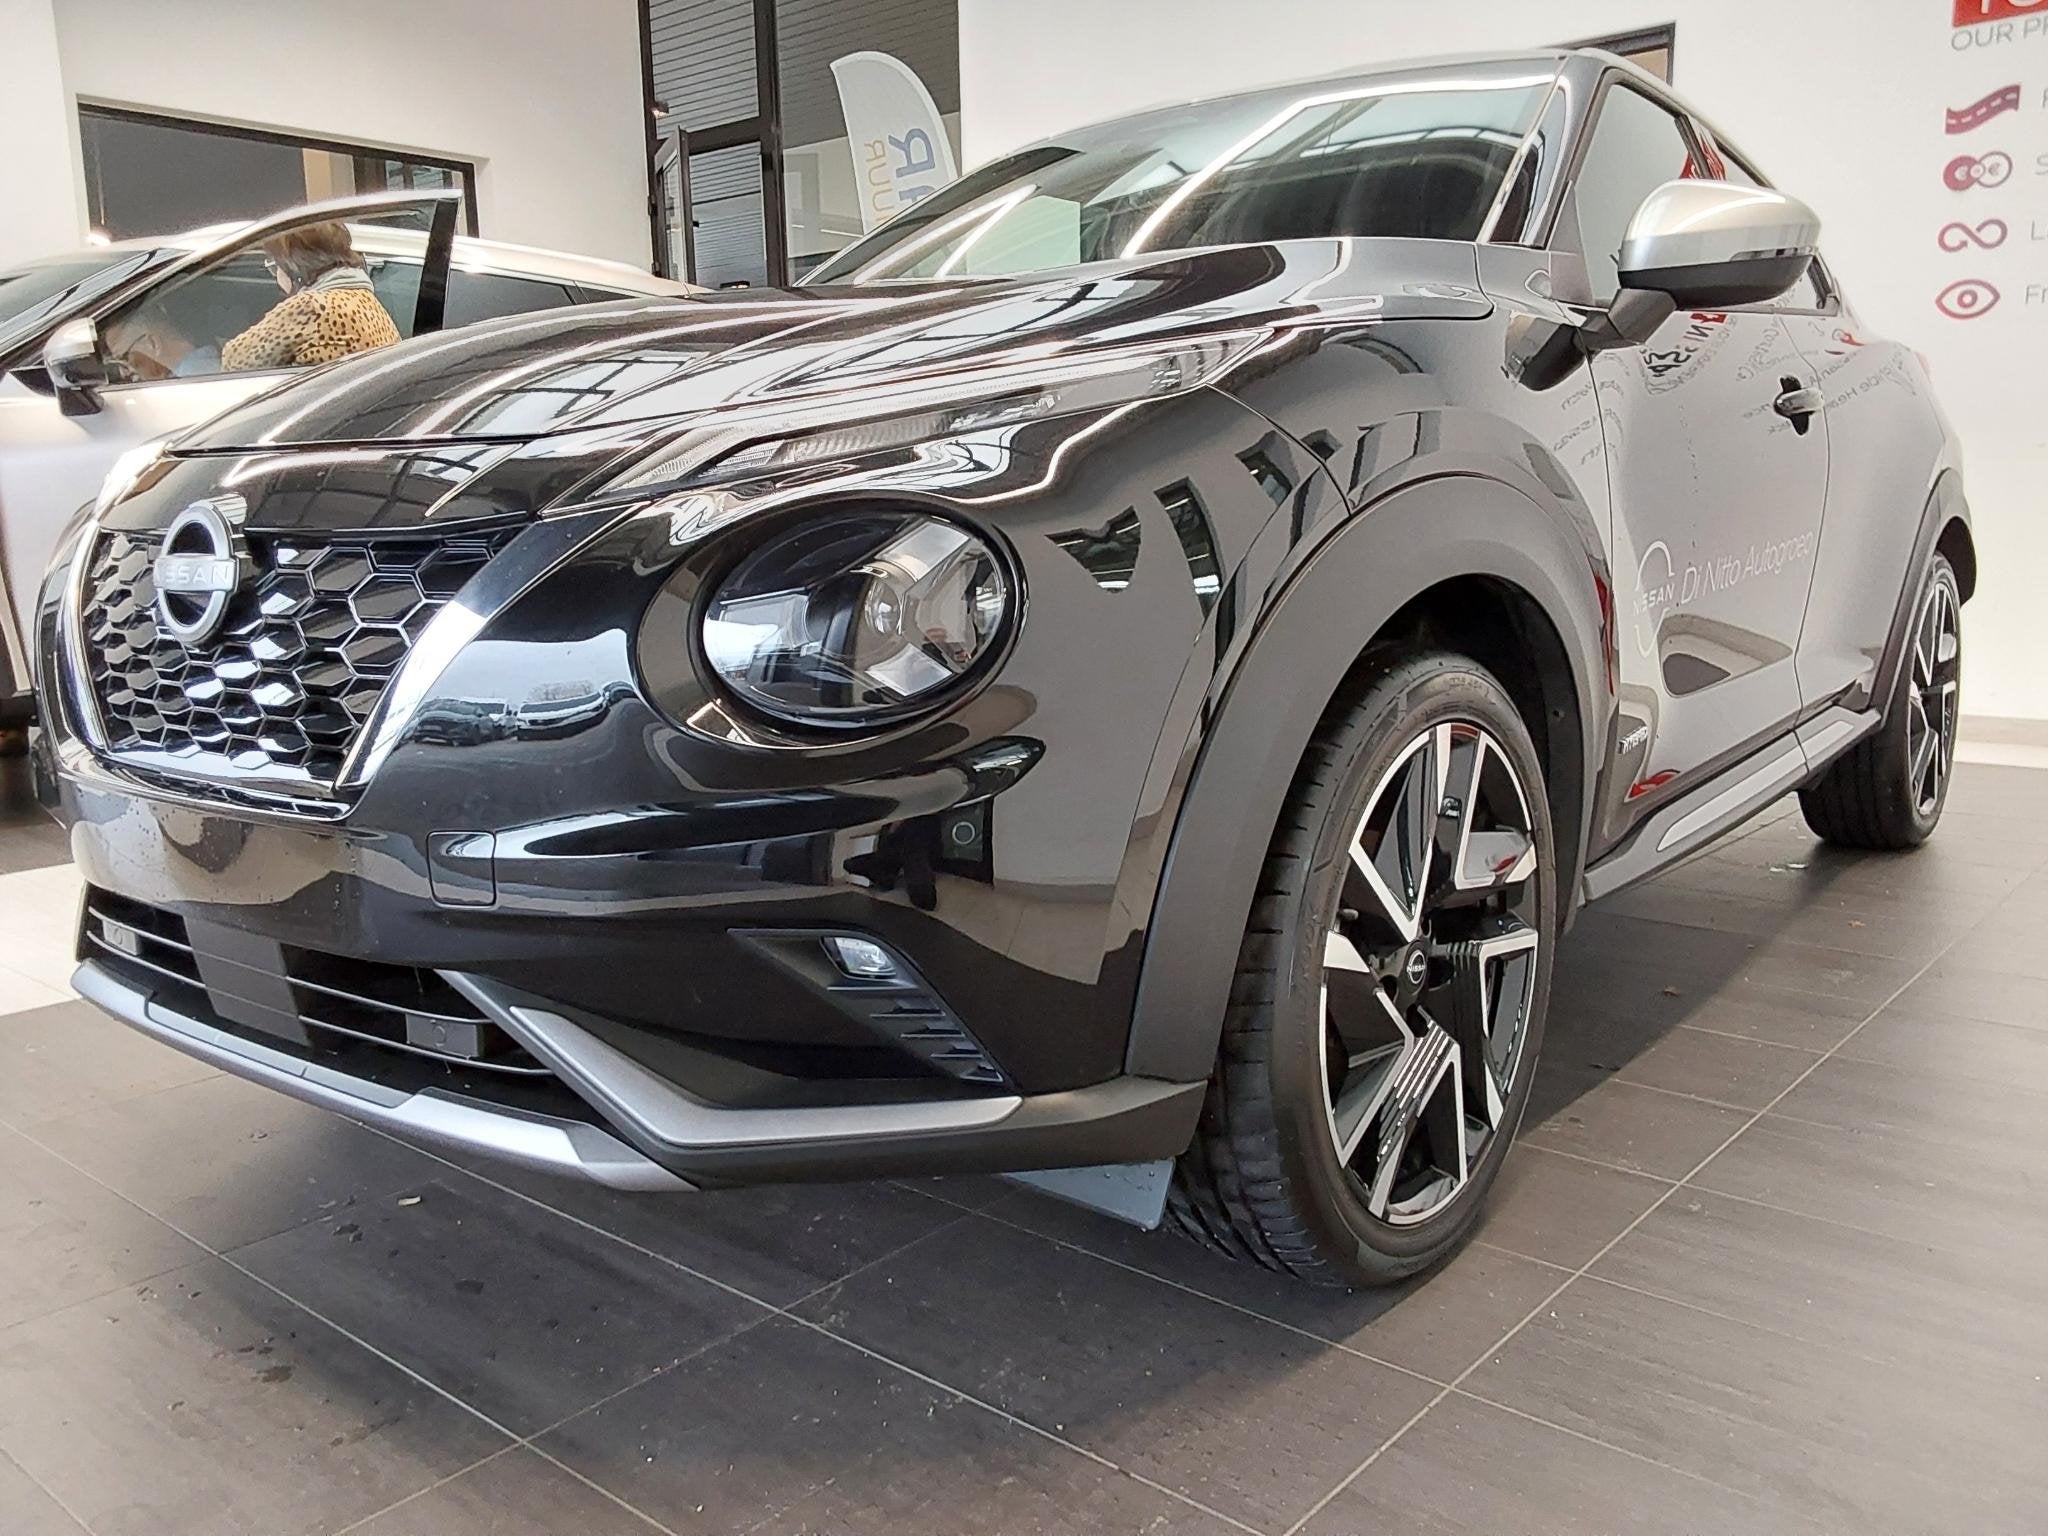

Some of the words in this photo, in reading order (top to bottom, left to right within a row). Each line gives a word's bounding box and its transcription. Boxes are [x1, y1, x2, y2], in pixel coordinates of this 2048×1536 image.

[1951, 23, 2014, 51] OUR
[1681, 564, 1703, 604] Di
[1703, 553, 1742, 597] Nitto
[1743, 530, 1814, 579] Autogroep
[1633, 582, 1676, 616] NISSAN
